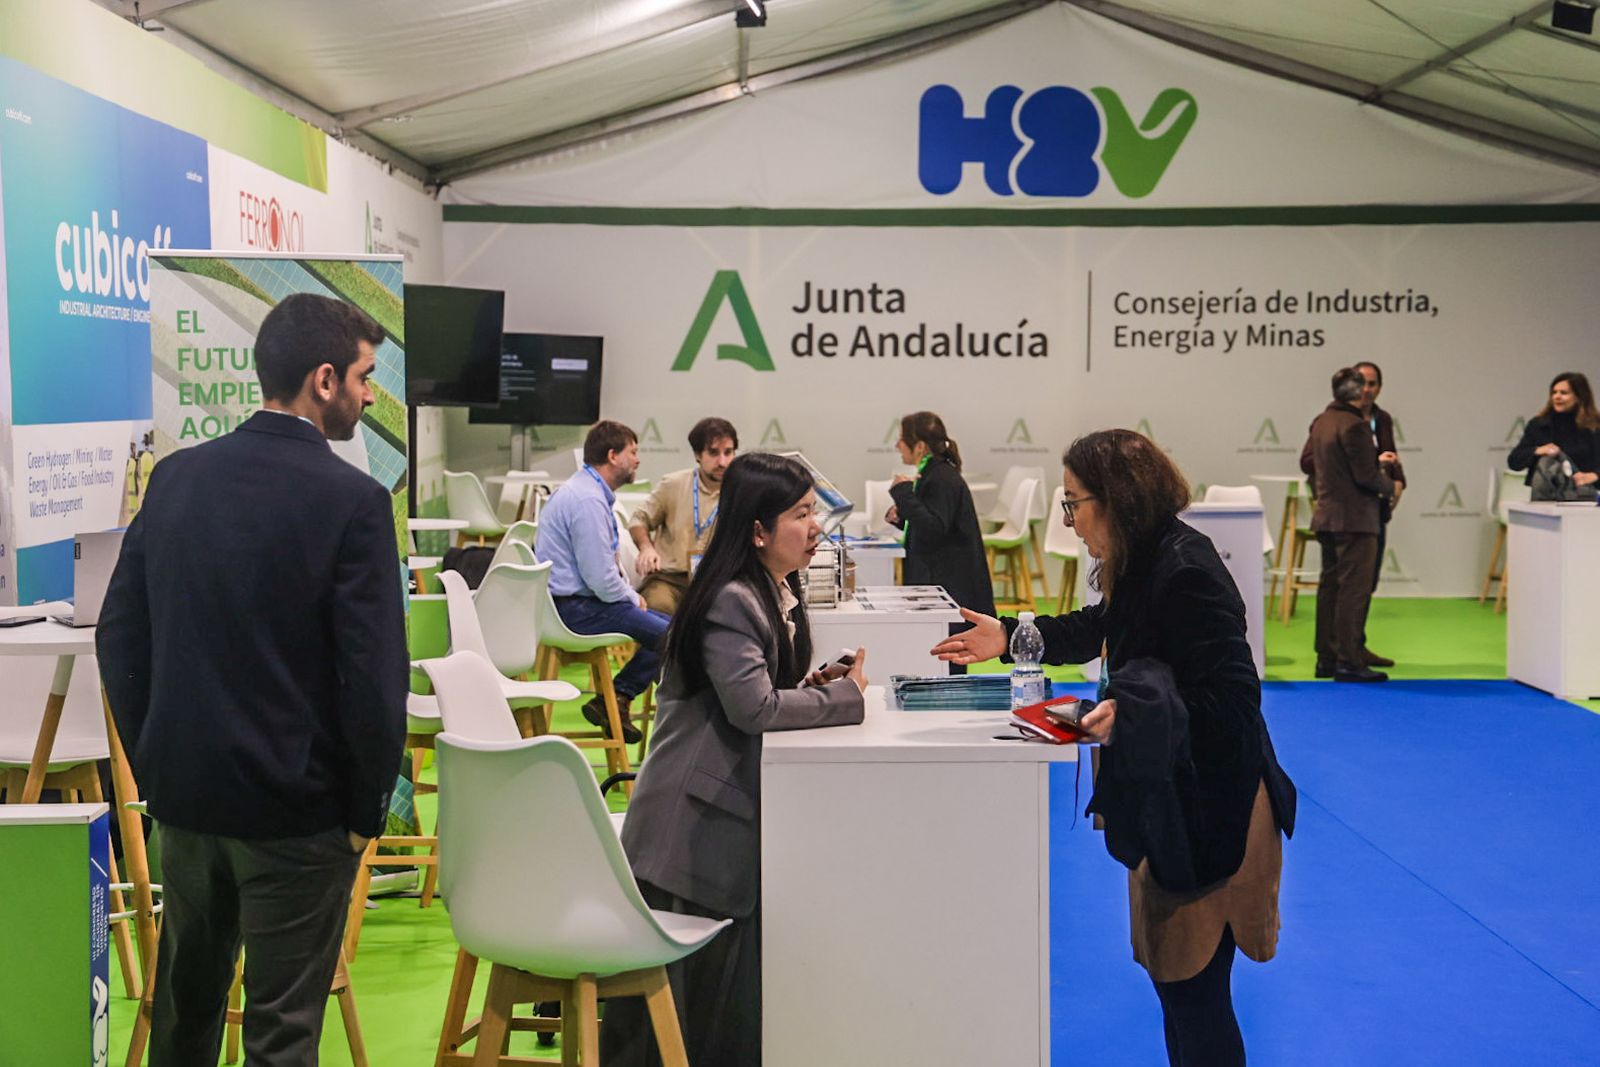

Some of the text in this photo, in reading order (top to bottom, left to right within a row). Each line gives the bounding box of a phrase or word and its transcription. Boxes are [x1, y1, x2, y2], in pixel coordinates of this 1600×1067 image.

[59, 299, 91, 317] INDUSTRIAL
[792, 281, 906, 313] Junta
[1114, 287, 1439, 320] Consejería de Industria,
[176, 310, 205, 333] EL
[791, 319, 1048, 358] de Andalucía
[1114, 320, 1325, 354] Energía y Minas
[28, 451, 45, 469] Green
[46, 450, 72, 472] Hydrogen
[76, 447, 94, 467] Mining
[29, 476, 48, 497] Energy
[81, 470, 94, 486] Food
[30, 498, 83, 518] Waste Management
